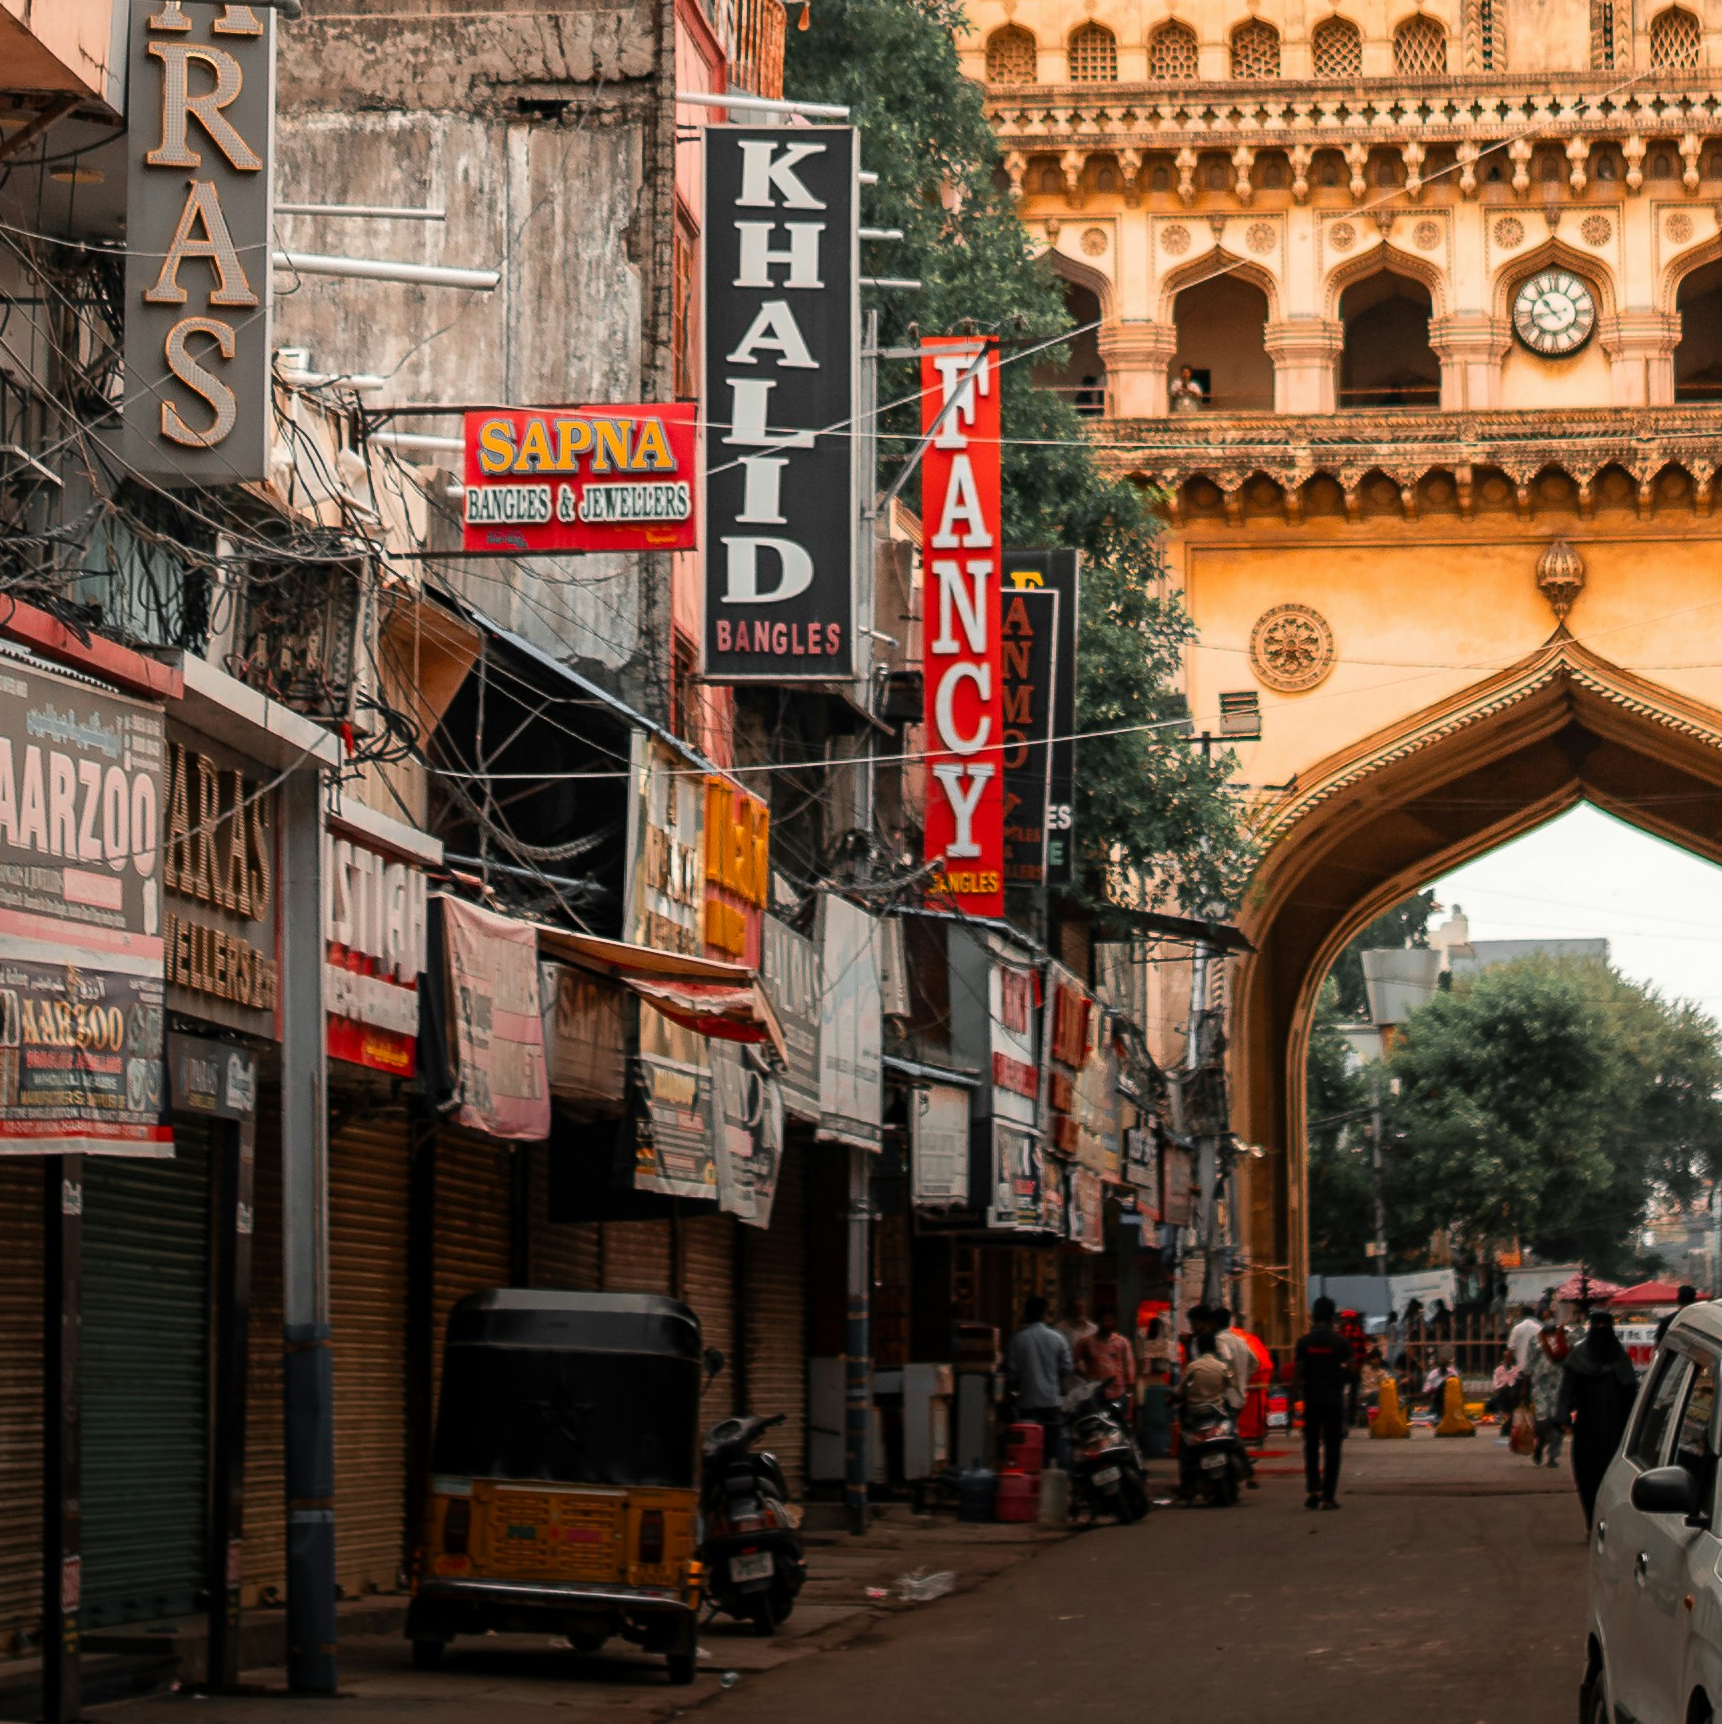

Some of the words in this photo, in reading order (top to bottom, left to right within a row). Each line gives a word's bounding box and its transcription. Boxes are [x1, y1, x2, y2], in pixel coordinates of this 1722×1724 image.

[720, 141, 827, 605] KHALID
[477, 418, 676, 474] SAPNA
[465, 484, 553, 524] BANGLES
[558, 484, 576, 523] &
[578, 481, 692, 522] JEWELLERS
[930, 354, 997, 858] FANCY
[716, 619, 841, 656] BANGLES
[927, 870, 998, 895] NGLES
